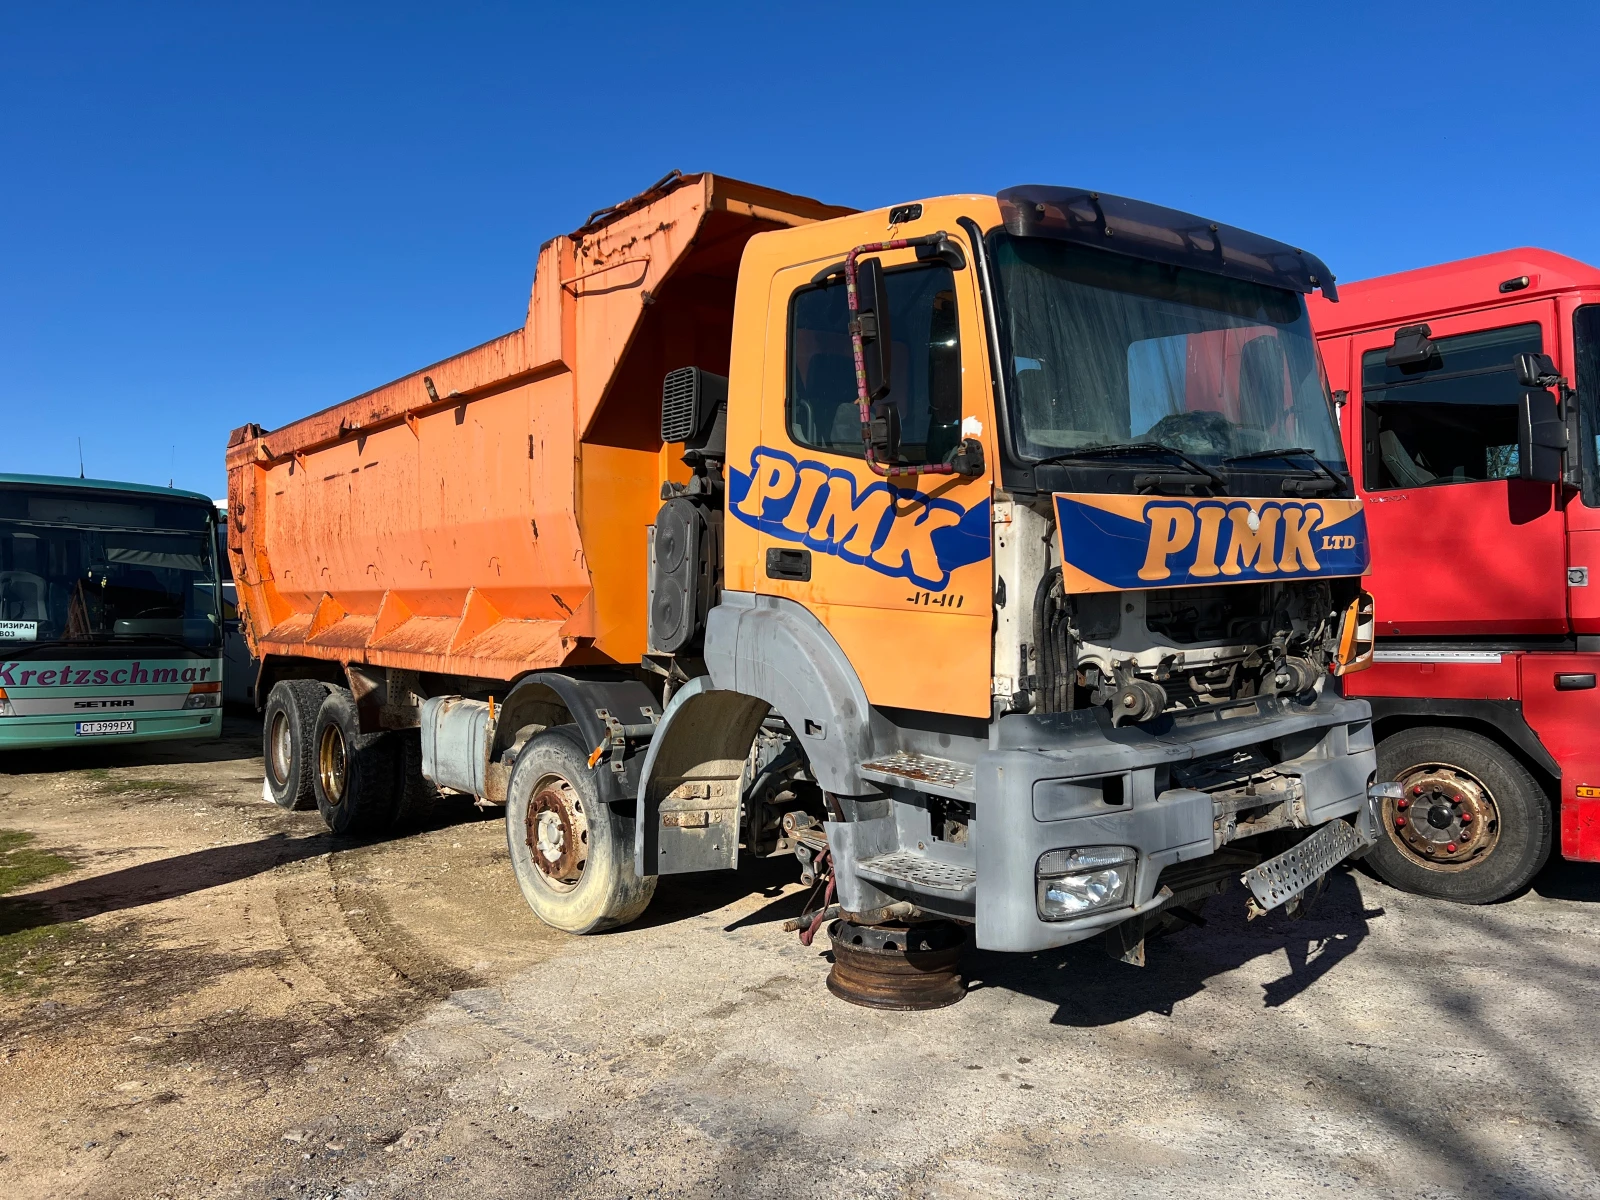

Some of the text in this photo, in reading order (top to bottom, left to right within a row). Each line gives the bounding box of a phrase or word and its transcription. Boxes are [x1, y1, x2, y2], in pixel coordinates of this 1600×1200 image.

[737, 454, 961, 583] PIMK
[1137, 506, 1356, 581] PIMK LTD
[0, 661, 211, 686] Kretzschmar
[74, 700, 135, 708] SETRA
